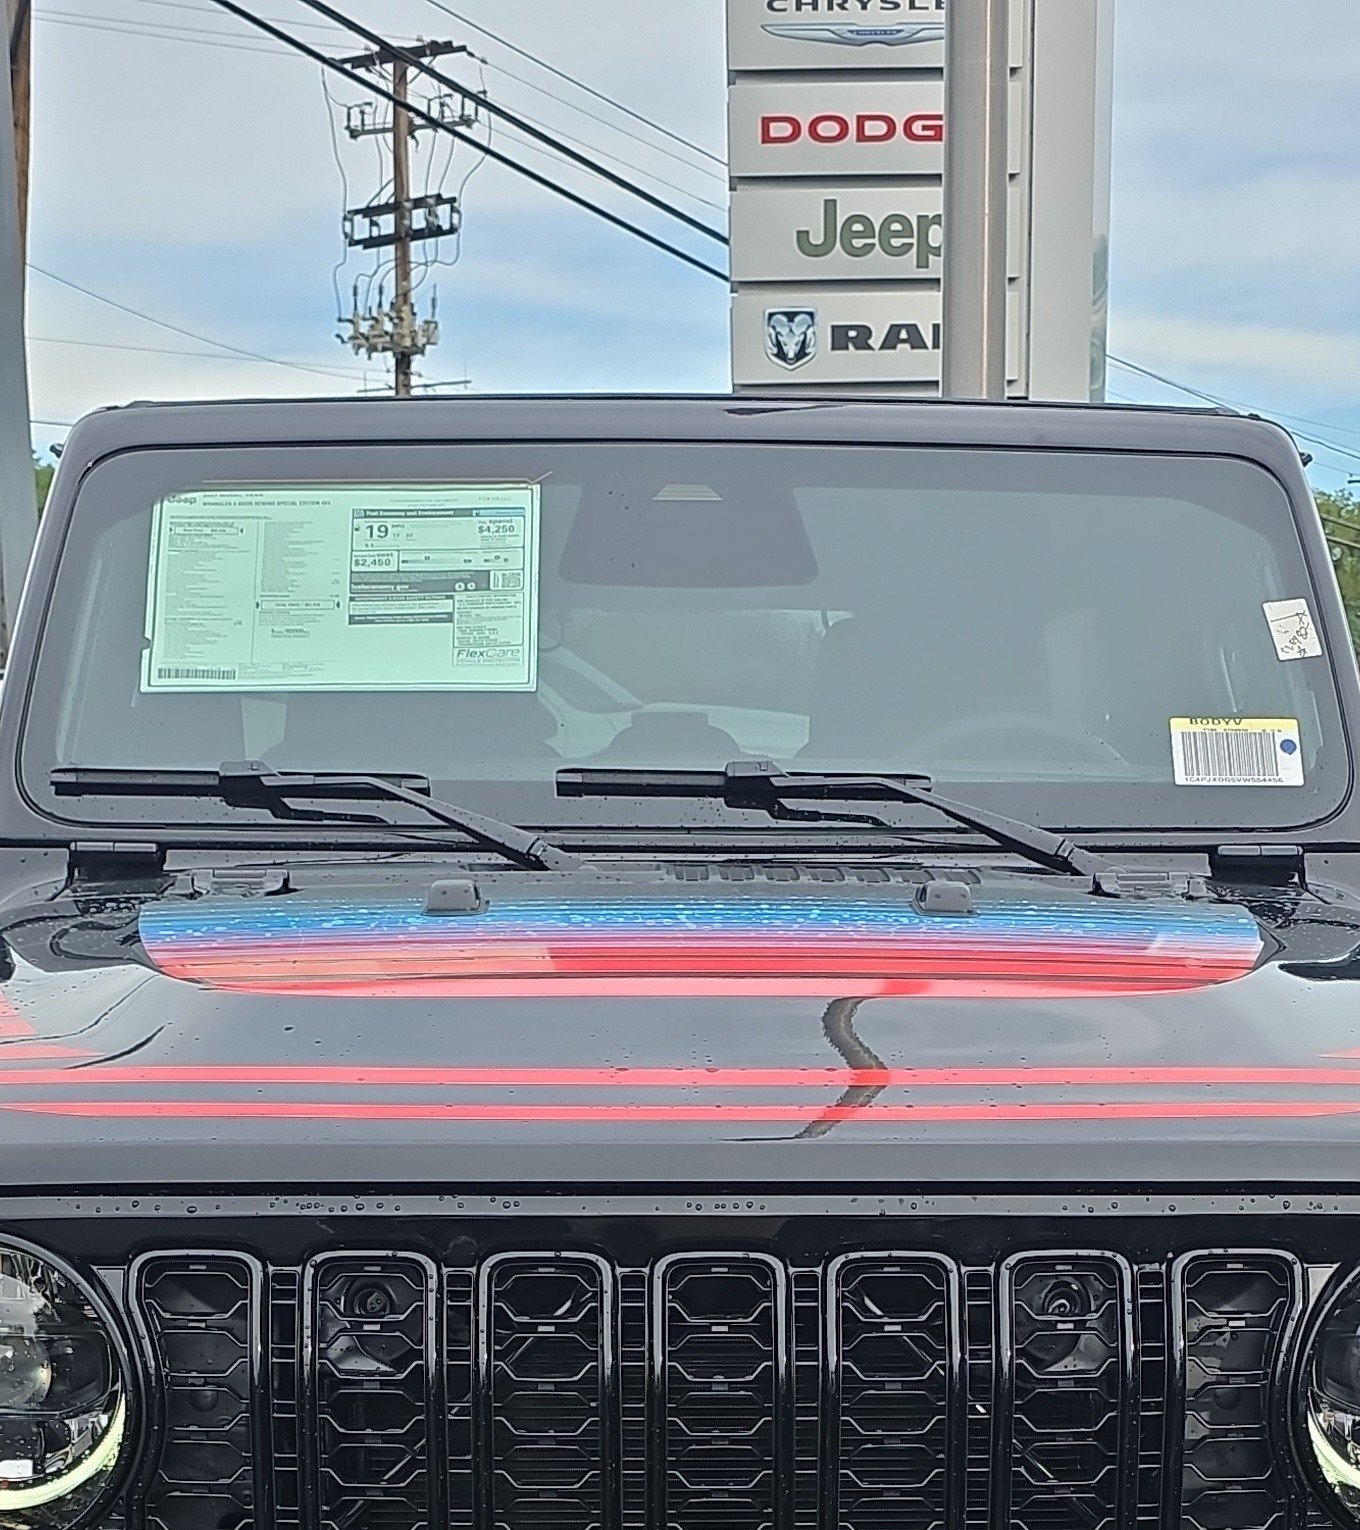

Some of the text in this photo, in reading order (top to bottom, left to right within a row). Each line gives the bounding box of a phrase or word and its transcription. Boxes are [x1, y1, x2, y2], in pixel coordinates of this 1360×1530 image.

[767, 0, 944, 12] CHRYSL
[760, 114, 944, 144] DODG
[796, 198, 943, 269] Jeep
[830, 323, 941, 352] RA
[365, 524, 389, 539] 19
[478, 525, 515, 534] $4,250
[353, 558, 391, 568] $2,450
[456, 648, 520, 658] FlexCare
